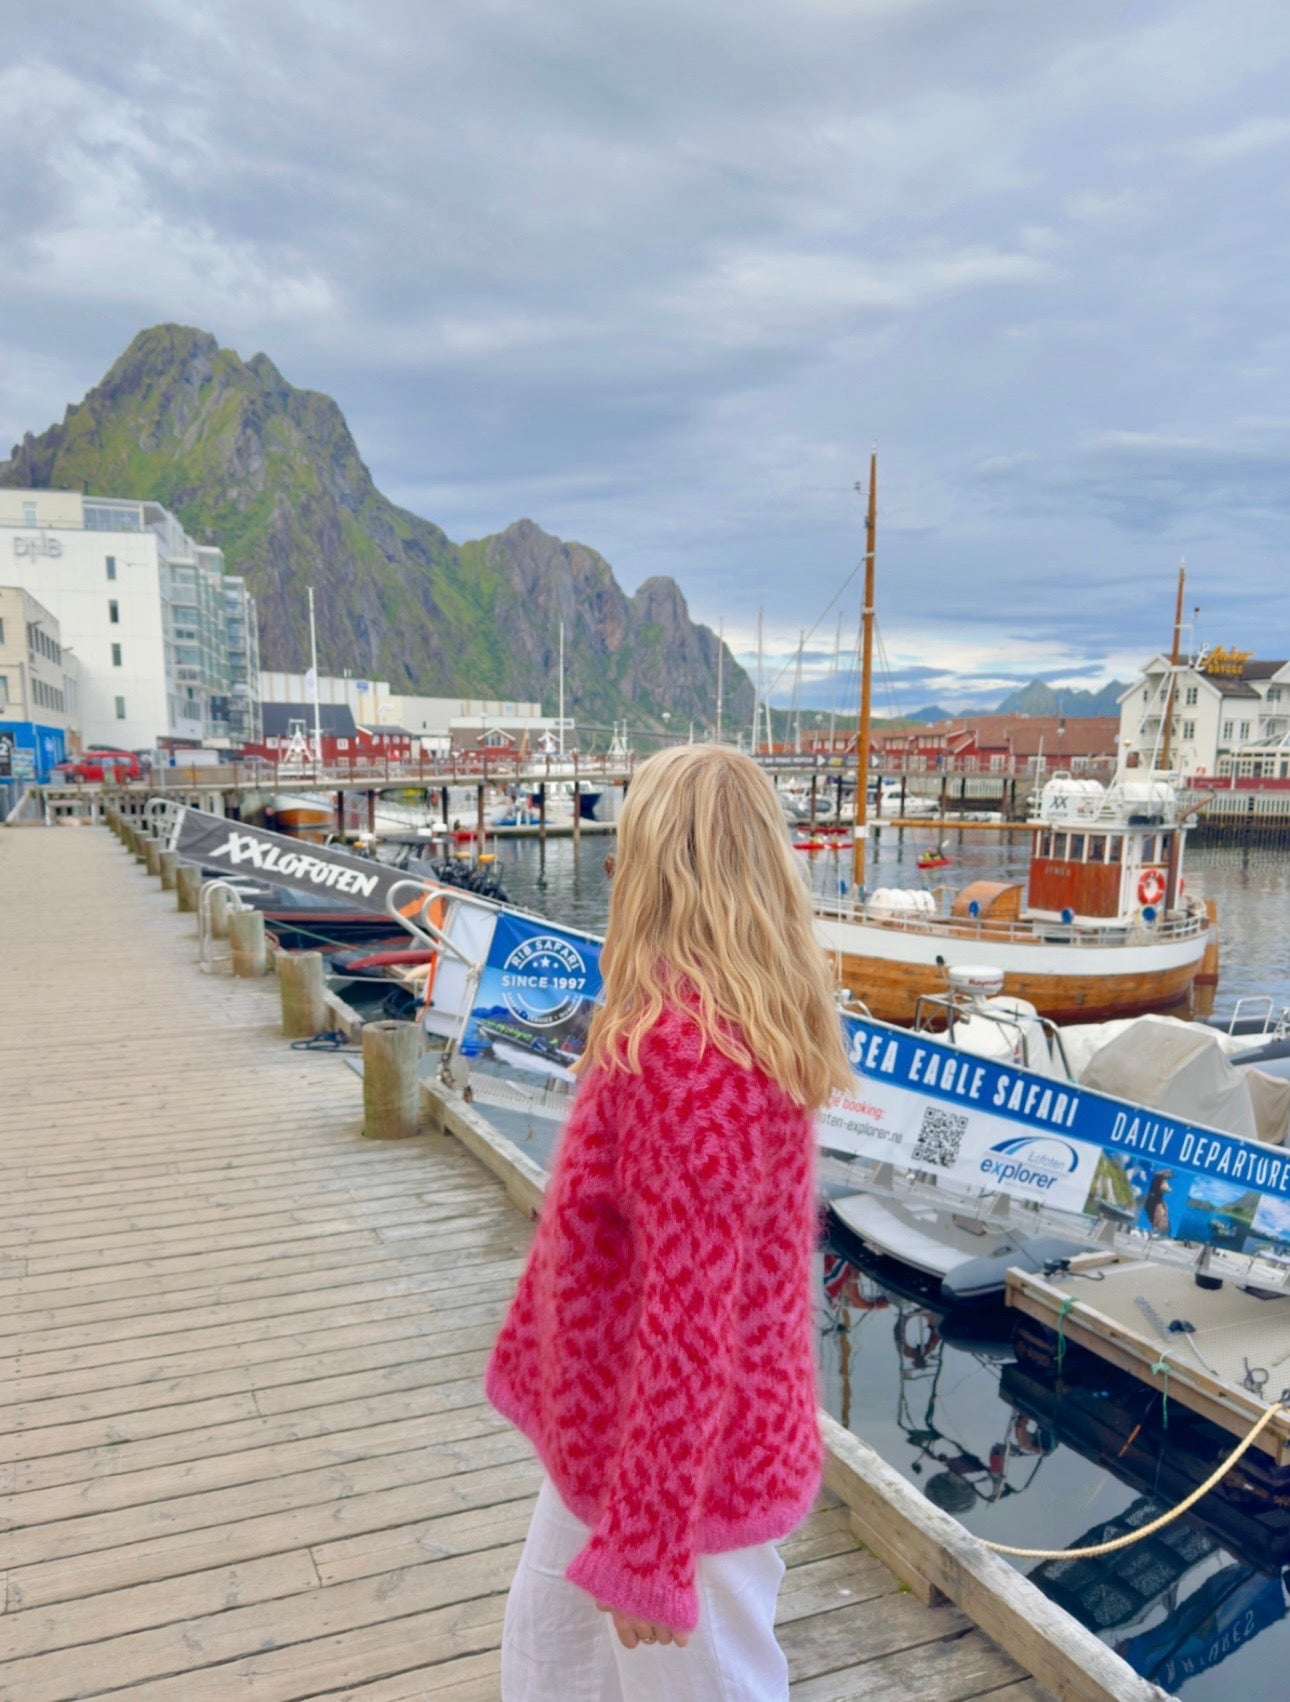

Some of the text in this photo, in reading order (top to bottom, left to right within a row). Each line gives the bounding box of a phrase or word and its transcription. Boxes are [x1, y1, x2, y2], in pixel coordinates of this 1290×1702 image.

[208, 831, 380, 898] XXLOFOTEN
[511, 940, 580, 969] RIB SAFARI
[501, 975, 587, 990] SINCE 1997
[851, 1030, 1080, 1128] SEA EAGLE SAFARI
[1110, 1112, 1175, 1156] DAILY
[979, 1158, 1058, 1190] explorer
[1027, 1150, 1066, 1169] Lofoten
